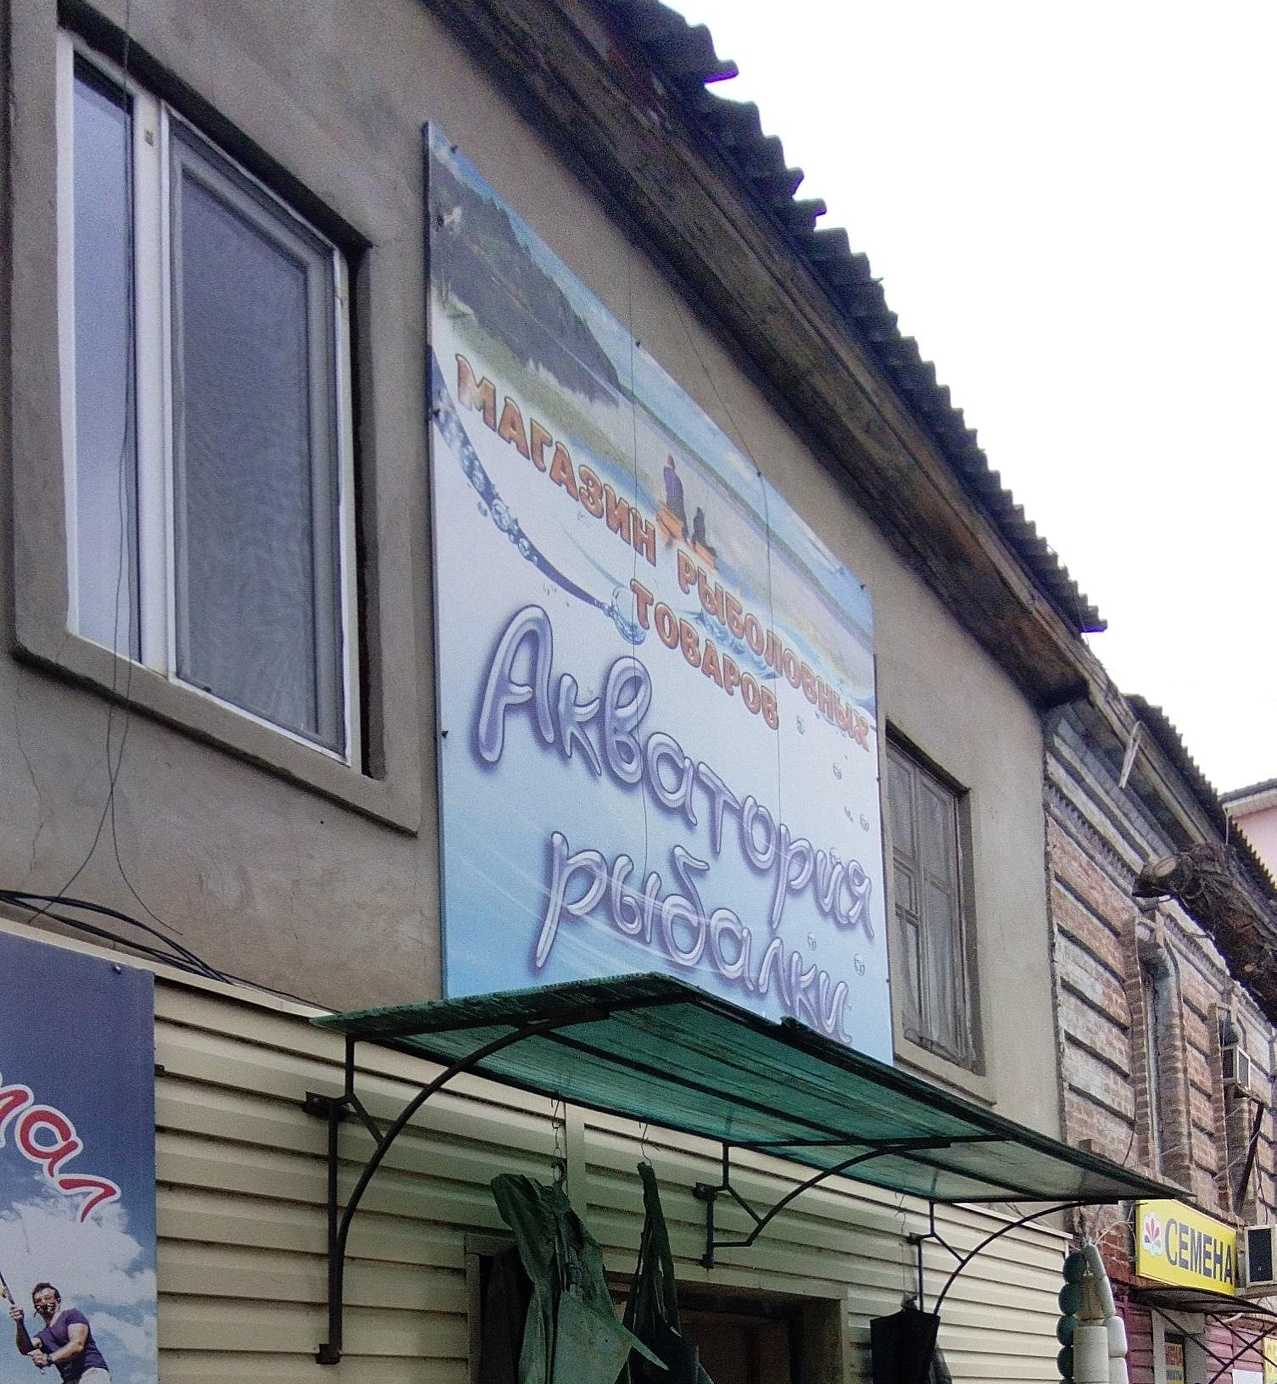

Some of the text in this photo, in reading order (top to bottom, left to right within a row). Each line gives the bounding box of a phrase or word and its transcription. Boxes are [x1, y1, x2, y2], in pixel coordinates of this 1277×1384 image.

[455, 353, 871, 752] МАГАЗИН РЫБОЛОВНЫХ
[629, 577, 780, 731] ТОВАРОВ
[478, 603, 875, 938] Акватория
[535, 831, 853, 1044] рыбалки
[1164, 1218, 1234, 1286] СЕМЕНА
